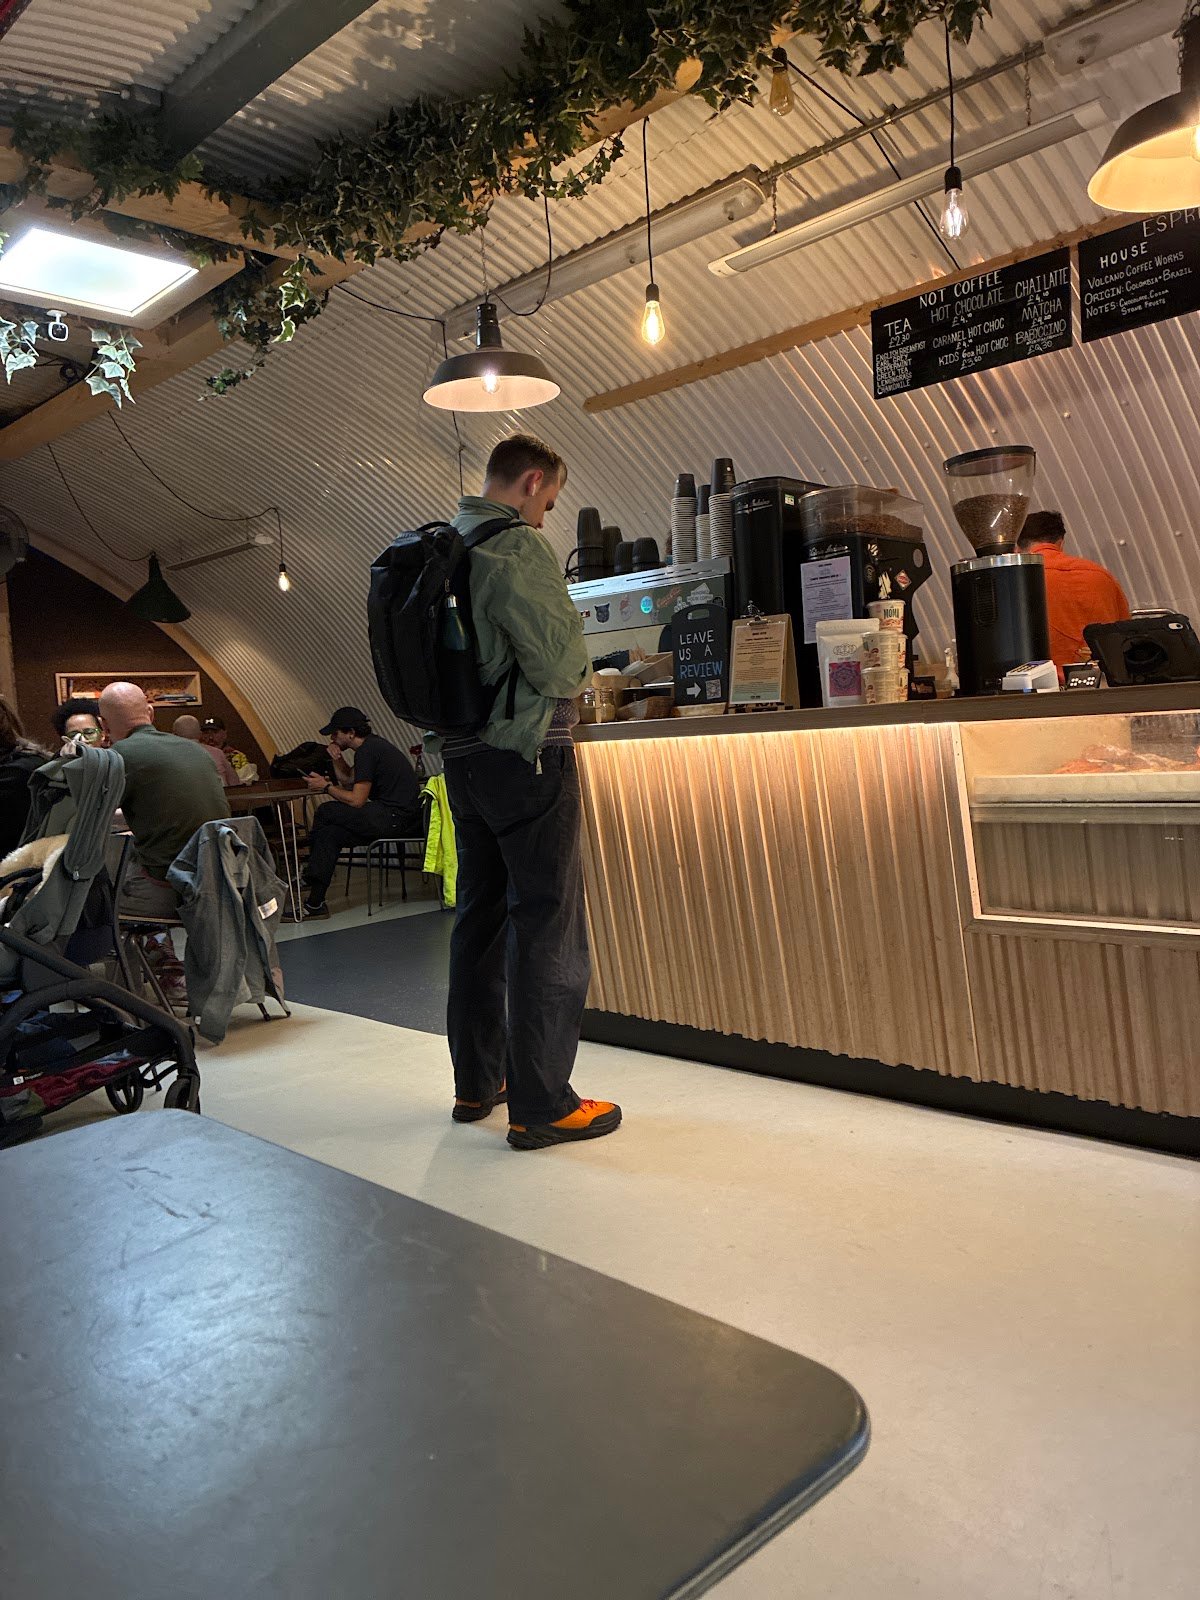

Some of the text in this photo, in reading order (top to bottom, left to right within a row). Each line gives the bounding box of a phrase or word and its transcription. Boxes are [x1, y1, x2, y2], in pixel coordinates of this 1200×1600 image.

[1100, 241, 1148, 269] HOUSE
[1015, 266, 1069, 299] CHAI LATTE
[1087, 251, 1184, 289] VOLCANO COFFEE WORKS
[920, 269, 1003, 309] NOT COFFEE
[1084, 285, 1124, 305] ORIGIN:
[930, 286, 1005, 324] HOT CHOCOLATE
[1021, 297, 1063, 322] MATCHA
[1086, 301, 1119, 319] NOTES:
[883, 317, 912, 336] TEA
[932, 317, 1005, 349] CARAMEL HOT CHOC
[1015, 318, 1067, 345] BABYCCINO
[888, 332, 911, 349] £2.30
[938, 351, 960, 367] KIDS
[975, 342, 990, 356] HOT
[990, 336, 1009, 352] CHOC
[679, 629, 714, 645] LEAVE
[678, 644, 713, 661] US A
[680, 660, 723, 679] REVIEW
